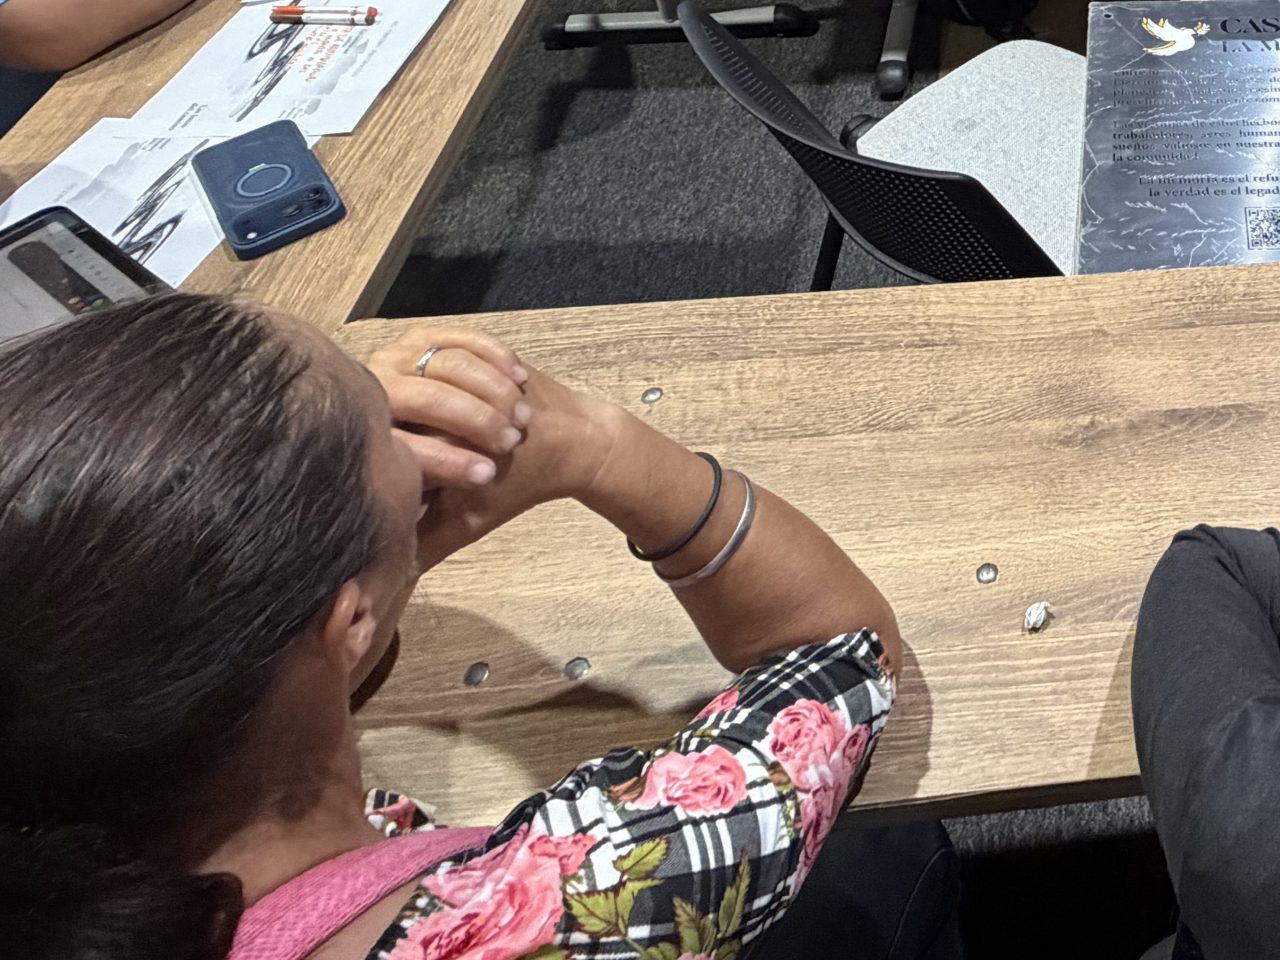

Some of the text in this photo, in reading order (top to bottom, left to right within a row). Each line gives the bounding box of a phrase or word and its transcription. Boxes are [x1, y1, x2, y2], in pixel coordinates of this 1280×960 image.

[1221, 40, 1253, 53] LA
[1112, 153, 1126, 162] la
[1221, 176, 1235, 184] es
[1238, 173, 1250, 183] el
[1148, 186, 1161, 197] la
[1213, 188, 1227, 196] es
[1230, 185, 1241, 196] el
